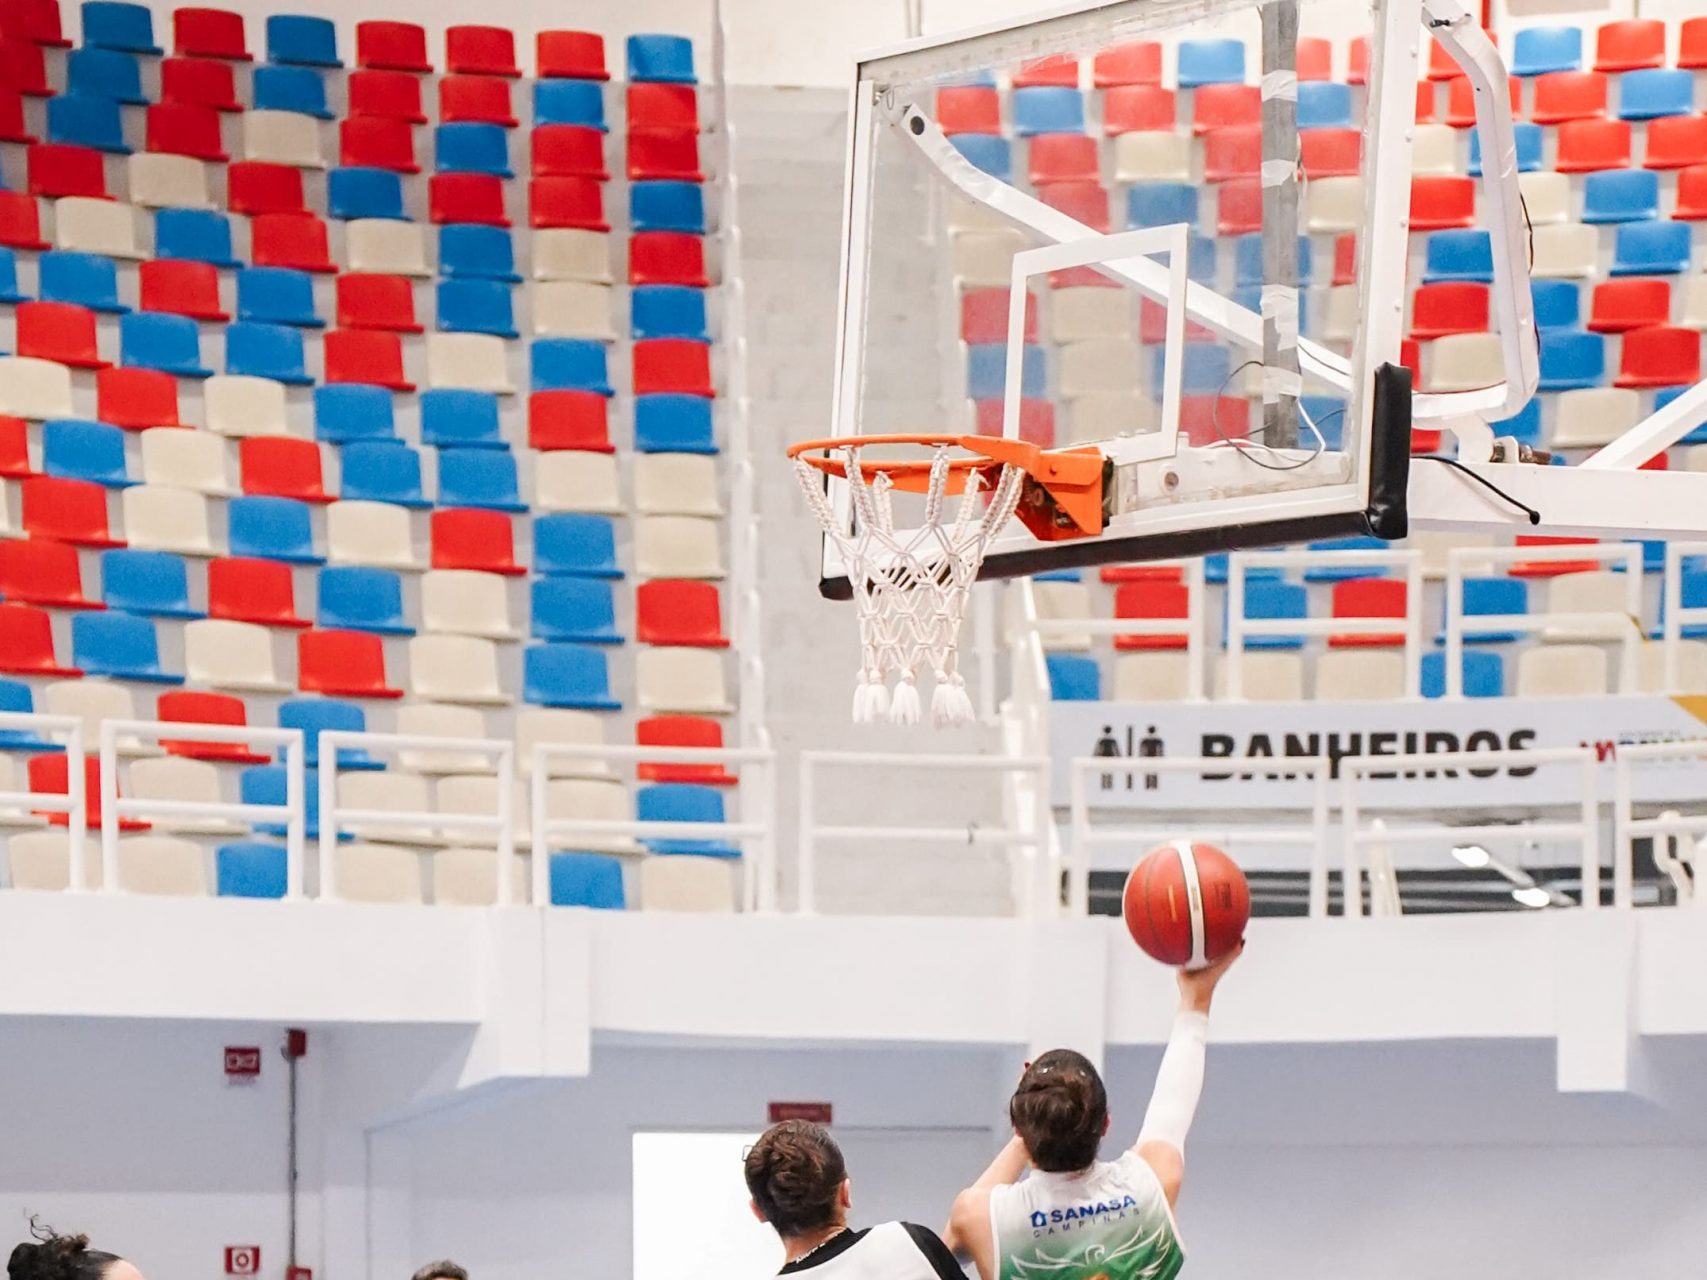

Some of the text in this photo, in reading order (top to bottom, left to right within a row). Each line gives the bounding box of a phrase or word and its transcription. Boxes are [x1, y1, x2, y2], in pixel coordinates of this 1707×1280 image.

[1201, 730, 1537, 780] BANHEIROS
[1033, 1208, 1140, 1238] CAMPINAS
[1050, 1195, 1136, 1223] SANASA
